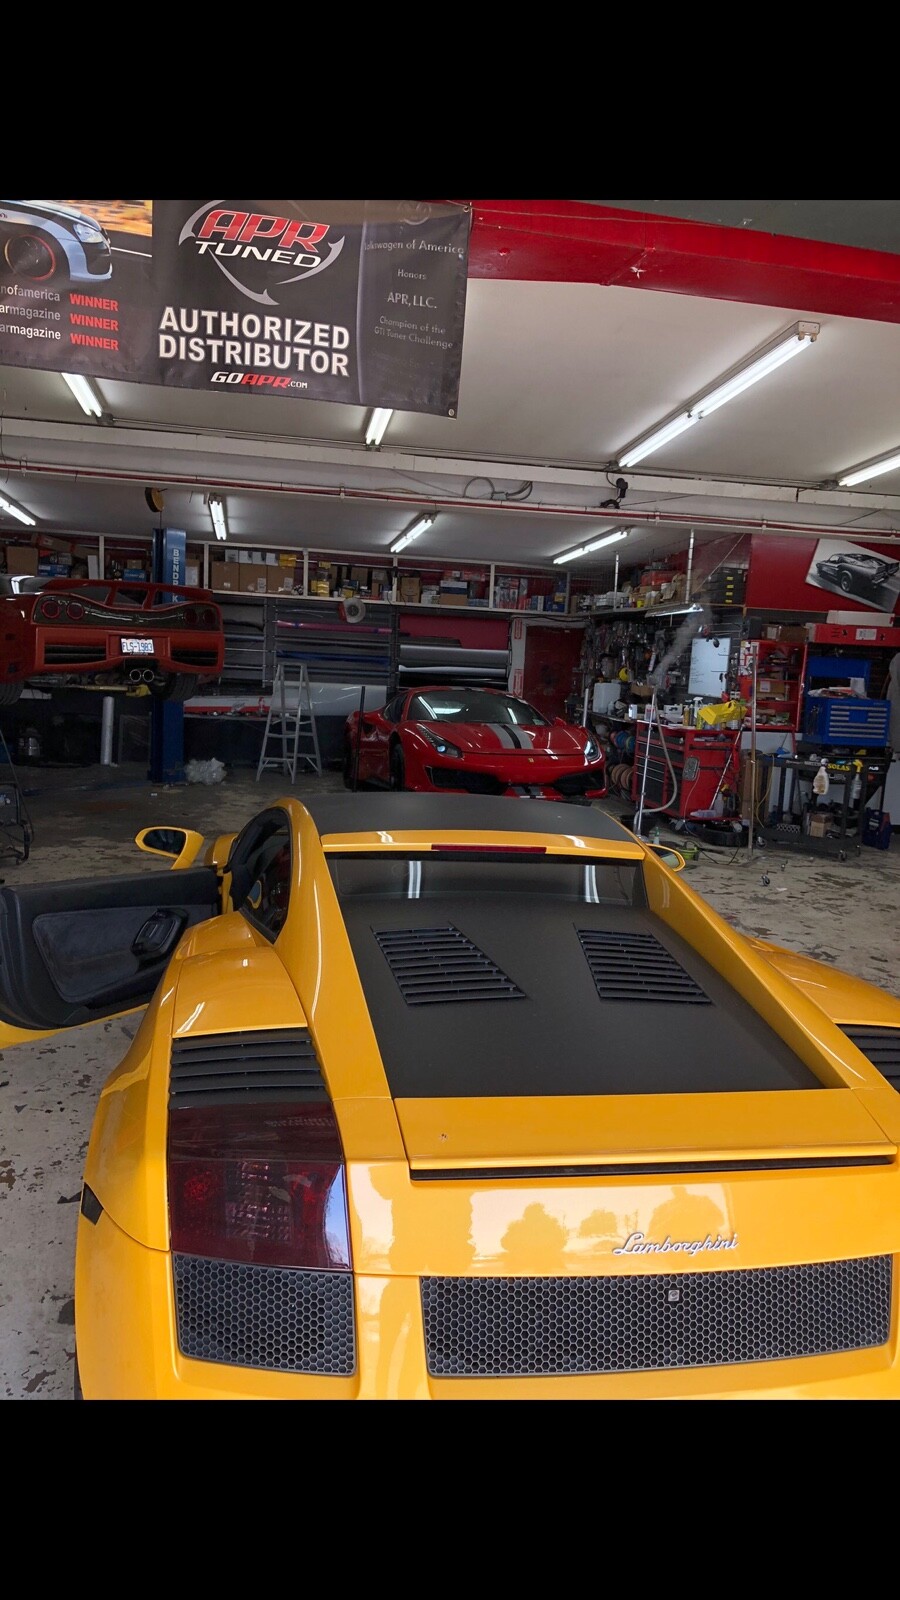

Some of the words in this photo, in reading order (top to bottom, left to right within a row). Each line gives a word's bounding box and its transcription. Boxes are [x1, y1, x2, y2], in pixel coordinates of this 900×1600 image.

[197, 209, 330, 253] APR
[195, 241, 322, 268] TUNED
[406, 239, 416, 250] of
[419, 240, 465, 254] America
[397, 268, 427, 280] Honors
[69, 293, 119, 312] WINNER
[69, 313, 119, 332] WINNER
[158, 305, 351, 350] AUTHORIZED
[379, 315, 418, 329] Champion
[420, 323, 430, 332] of
[431, 324, 446, 335] the
[69, 333, 119, 351] WINNER
[374, 326, 385, 336] GTI
[386, 328, 406, 341] Tuner
[408, 333, 454, 350] Challenge
[158, 334, 351, 378] DISTRIBUTOR
[172, 548, 180, 603] BENDPK
[612, 1231, 739, 1256] Lamborghini
